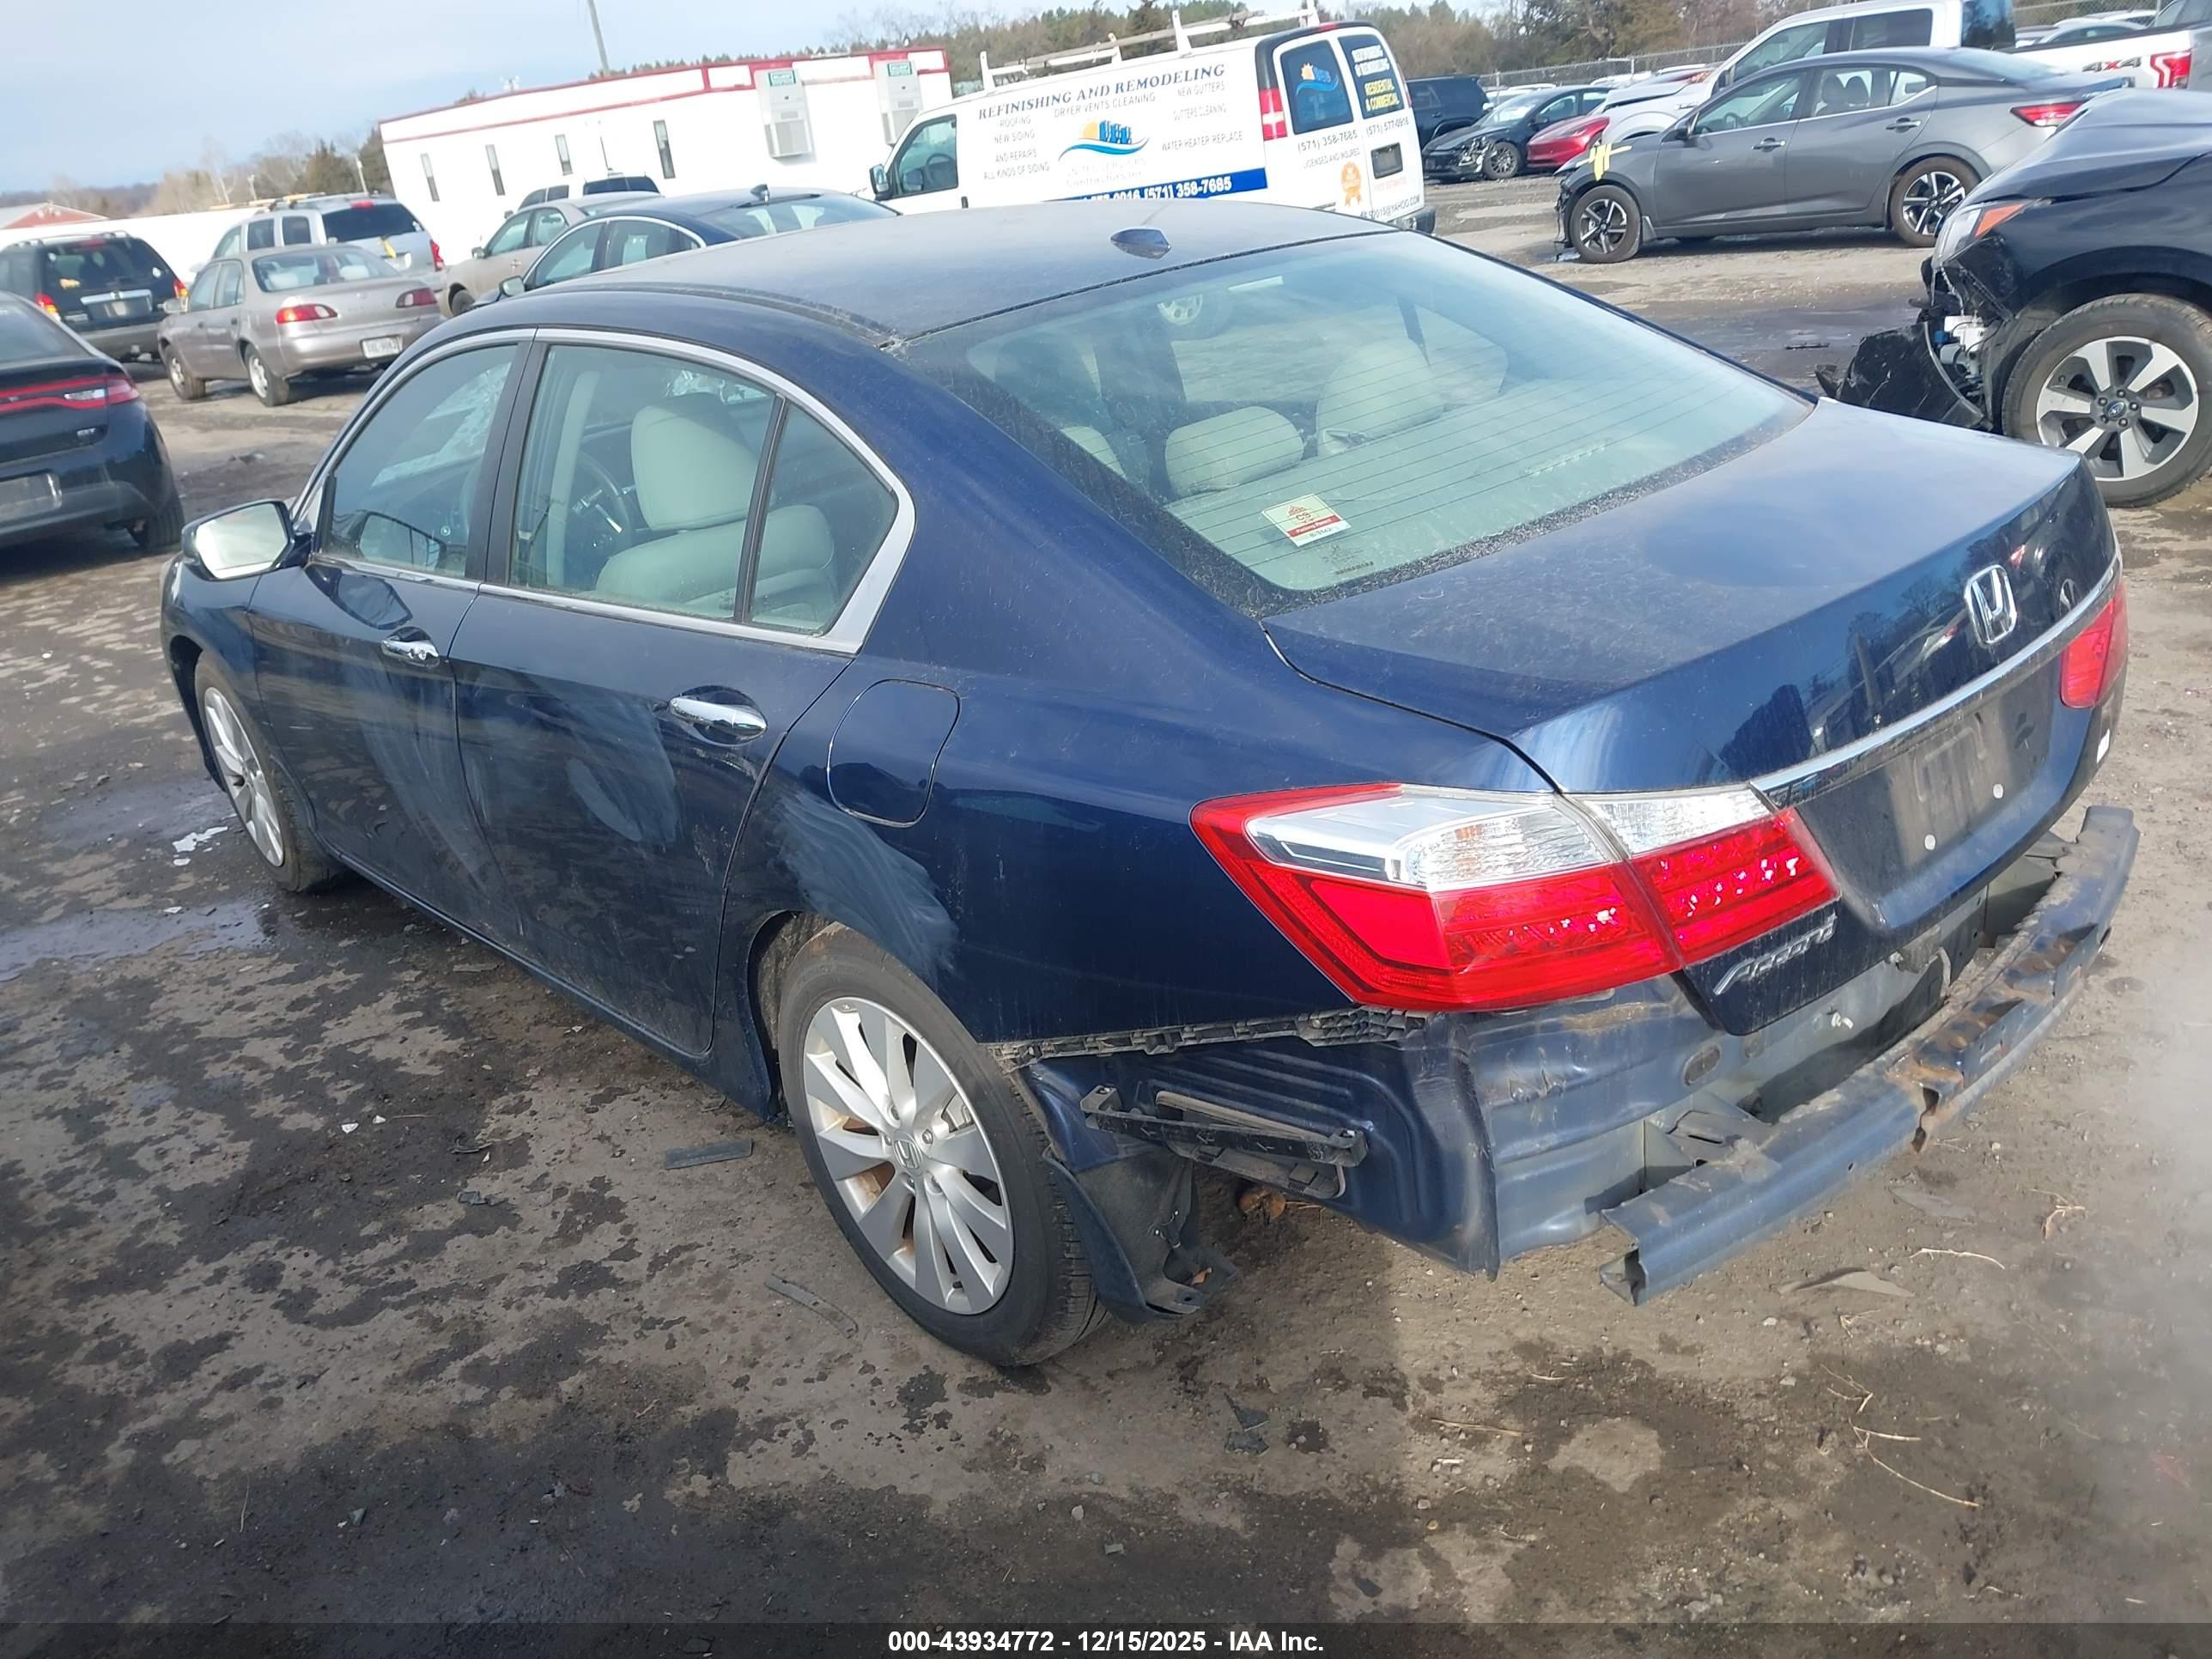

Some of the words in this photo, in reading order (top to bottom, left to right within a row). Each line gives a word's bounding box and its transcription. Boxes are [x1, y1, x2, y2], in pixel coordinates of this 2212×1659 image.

[978, 92, 1072, 120] REFINISHING
[1077, 85, 1110, 101] AND
[1115, 64, 1225, 94] REMODELING
[1177, 87, 1192, 97] NEW
[1194, 81, 1225, 95] GUTTERS
[1054, 104, 1081, 118] DRYER
[1084, 100, 1110, 113] VENTS
[1112, 92, 1156, 108] CLEANING
[1000, 116, 1030, 128] ROOFING
[1366, 124, 1383, 137] (571)
[994, 134, 1009, 144] NEW
[1012, 130, 1036, 142] SIDING
[1162, 139, 1182, 151] WATER
[1184, 135, 1210, 148] HEATER
[1212, 131, 1243, 144] REPLACE
[1297, 140, 1321, 154] (571)
[1322, 130, 1358, 146] 358-7685
[1010, 149, 1037, 160] REPAIRS
[997, 167, 1016, 179] KINDS
[1018, 165, 1025, 175] OF
[1028, 161, 1050, 174] SIDING
[1176, 176, 1232, 198] 358-7685
